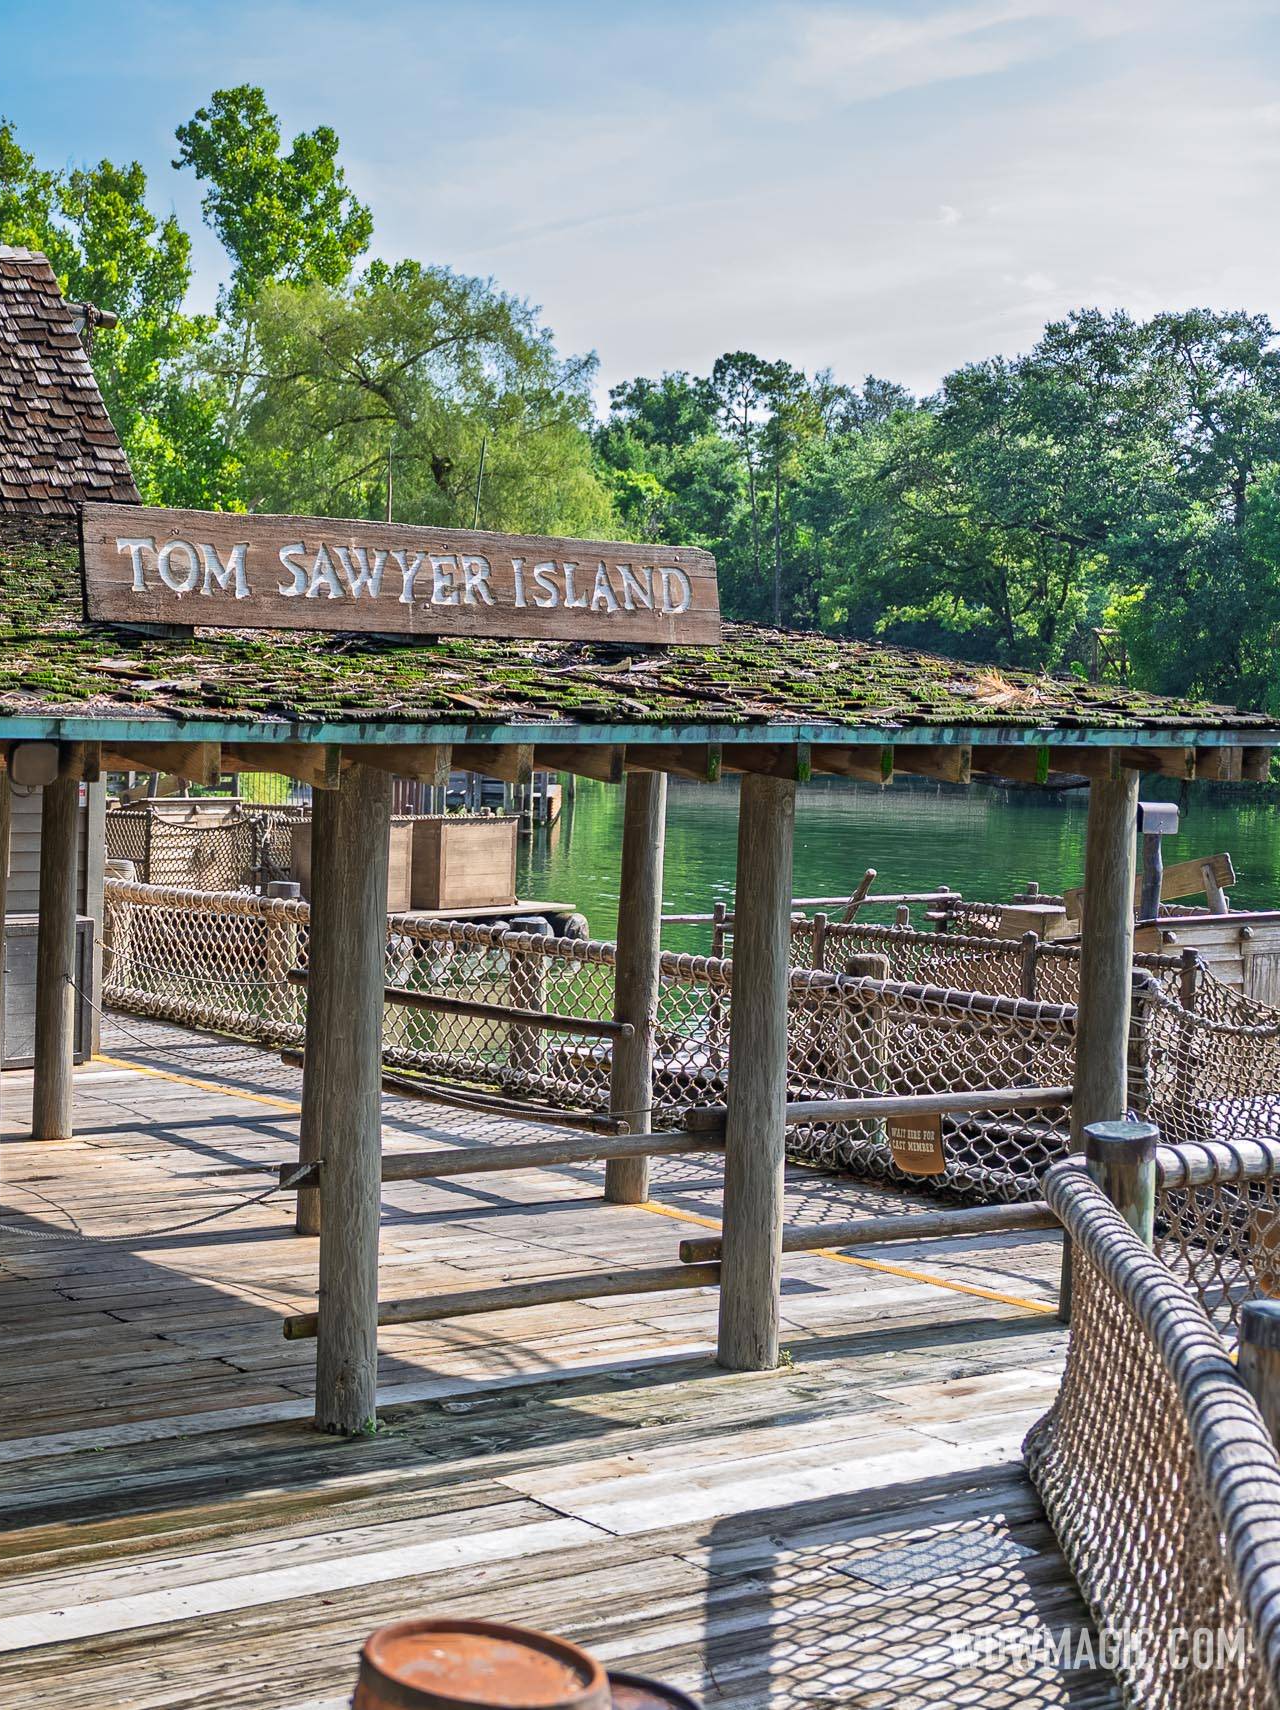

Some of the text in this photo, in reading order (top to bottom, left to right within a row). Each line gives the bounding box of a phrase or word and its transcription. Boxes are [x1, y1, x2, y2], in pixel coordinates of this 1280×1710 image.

[116, 535, 694, 615] TOM SAWYER ISLAND
[891, 1127, 935, 1141] WAIT HERE FOR
[892, 1140, 935, 1153] CAST MEMBER
